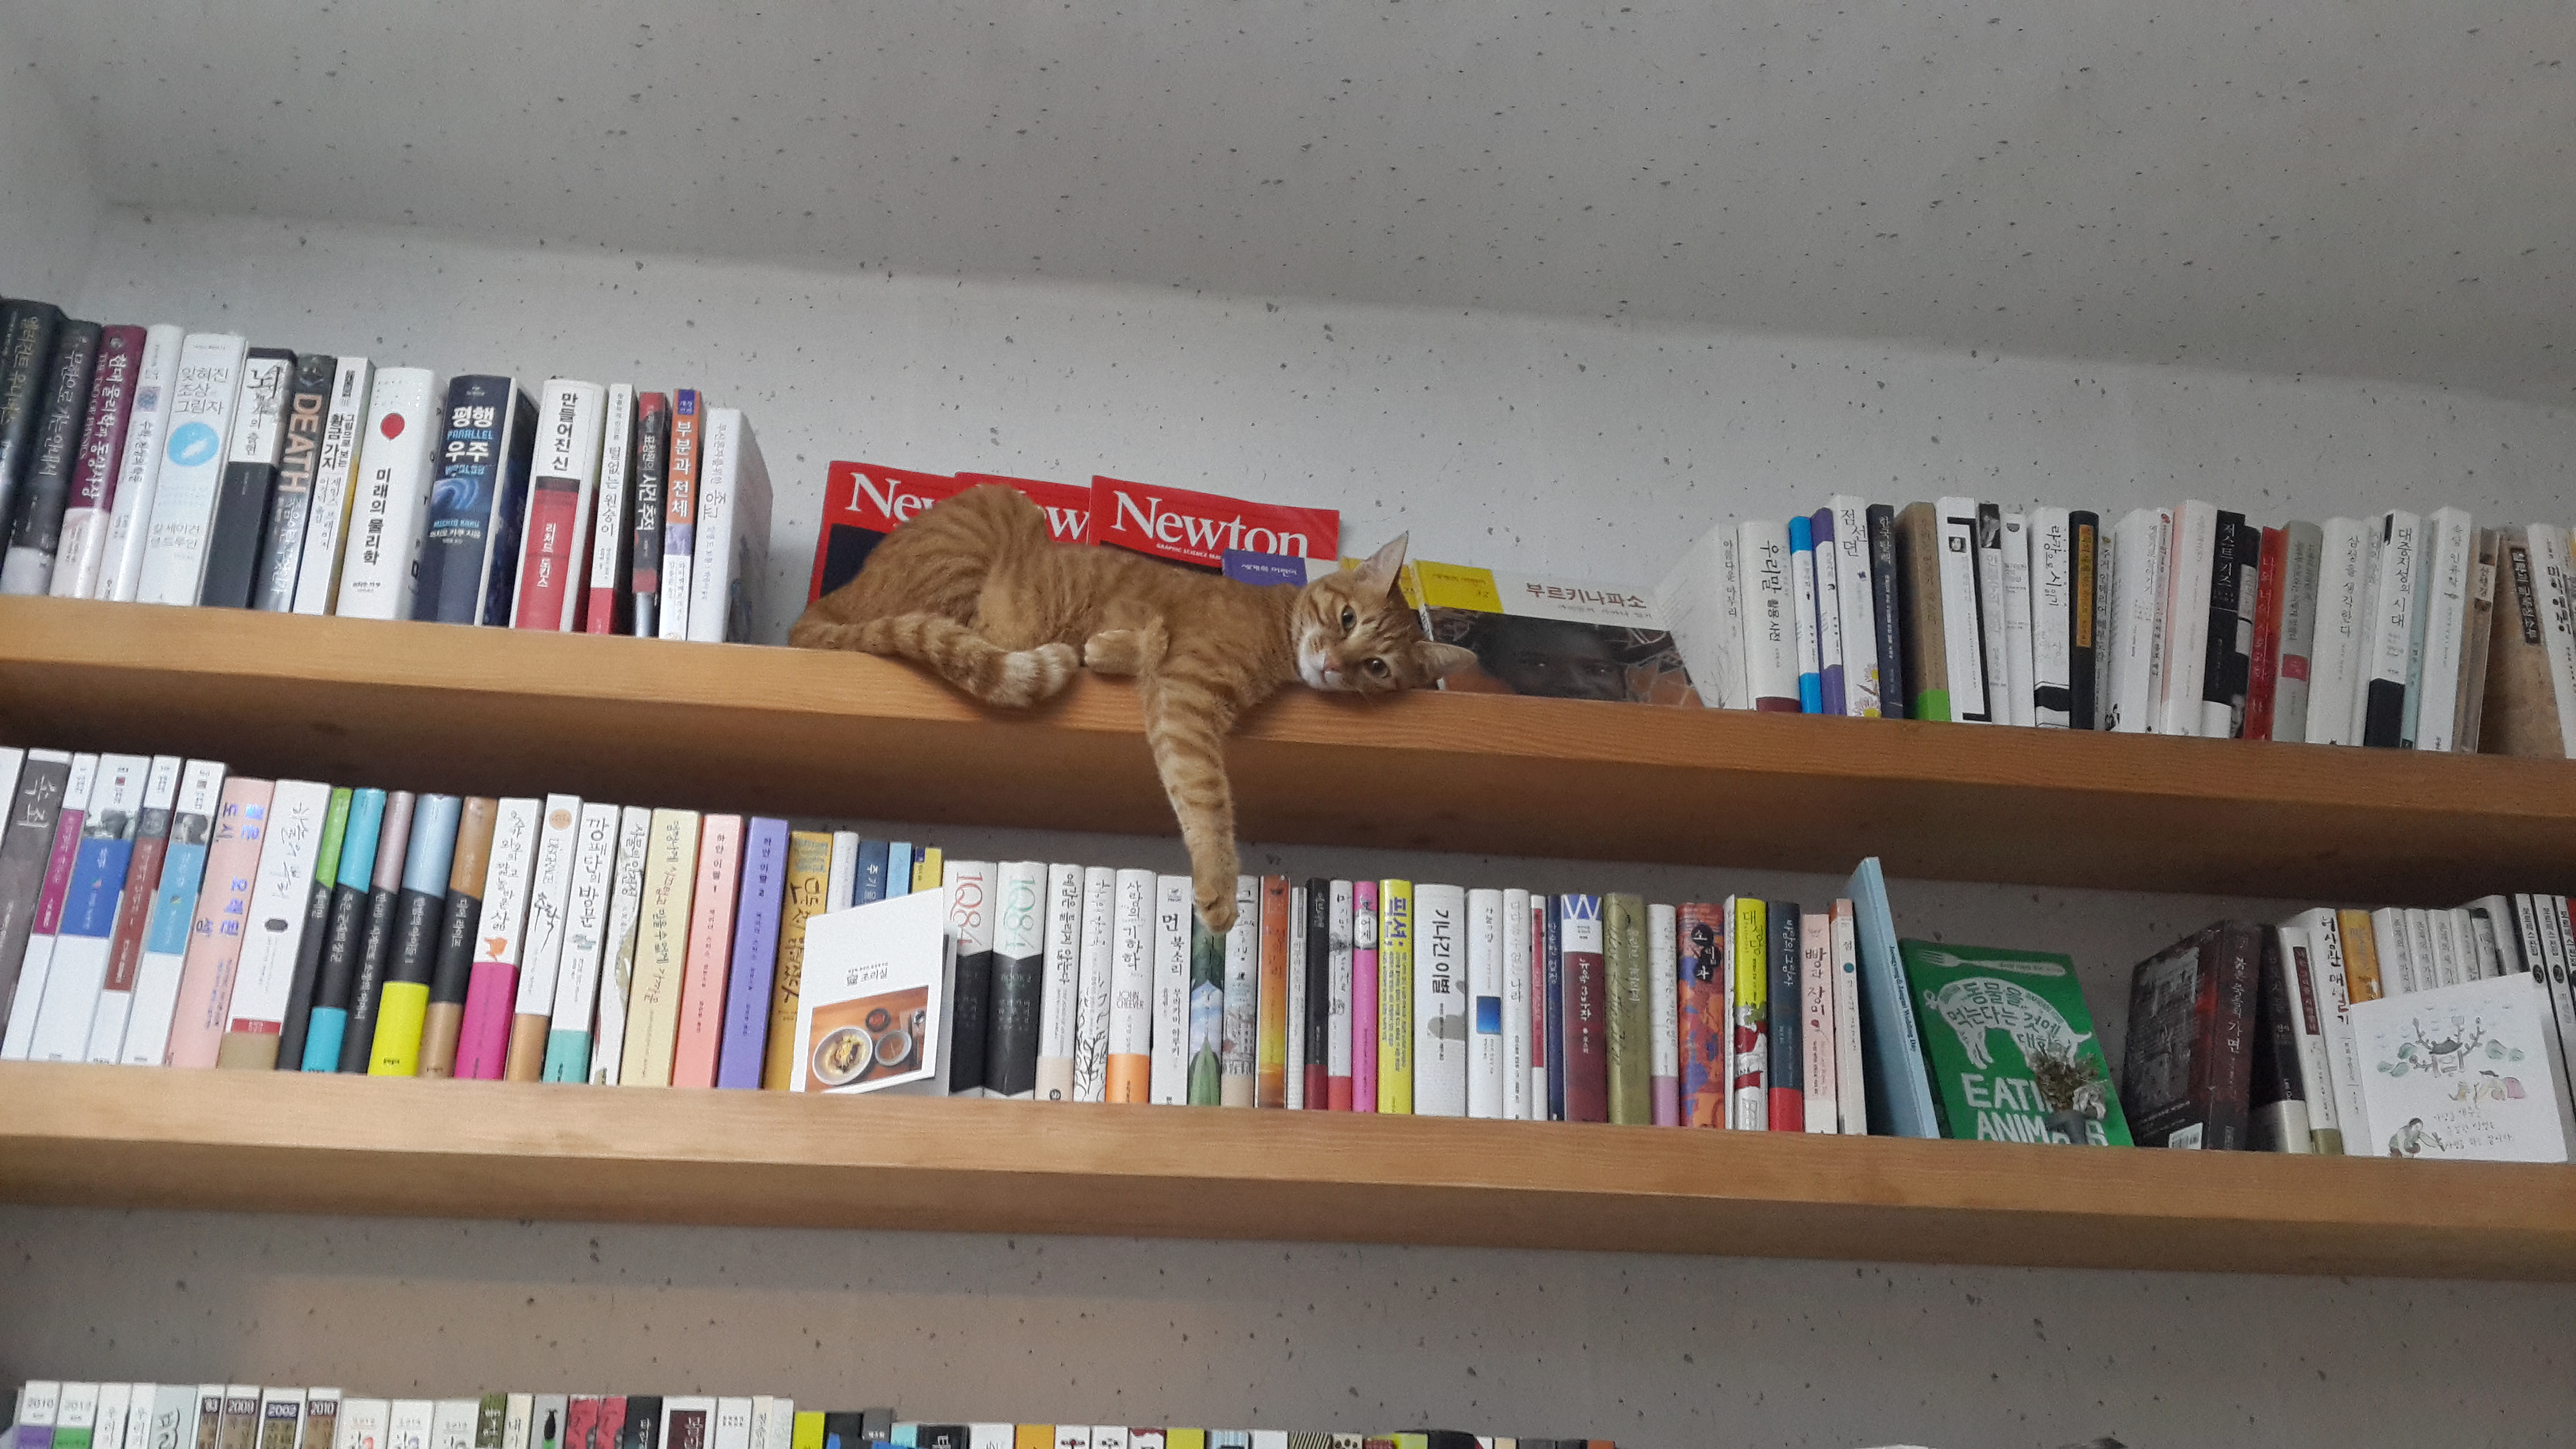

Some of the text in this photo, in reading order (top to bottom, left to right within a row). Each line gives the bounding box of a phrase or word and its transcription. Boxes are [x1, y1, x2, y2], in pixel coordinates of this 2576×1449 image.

[451, 406, 495, 429] 평행
[552, 391, 579, 473] 만들어진 신
[279, 393, 324, 494] DEATH
[321, 442, 340, 471] 가지
[444, 441, 490, 463] 우주
[369, 467, 393, 515] 미래의
[671, 421, 693, 519] 부분과 전체
[703, 489, 727, 520] 종교
[1109, 489, 1309, 559] Newton
[363, 518, 384, 565] 물리학
[1842, 509, 1868, 557] 점선면
[2218, 522, 2236, 588] 저스트 키즈
[1759, 539, 1782, 593] 우리말
[2391, 527, 2413, 629] 대중지성의 시대
[1526, 582, 1647, 609] 부르키나파소
[16, 774, 57, 829] 속죄
[578, 816, 610, 929] 깡패단의 방문
[864, 862, 879, 901] 주기율
[1061, 873, 1079, 908] 예감은
[220, 874, 248, 937] 오래된
[490, 909, 509, 932] 삶
[950, 871, 984, 947] 1Q84
[1003, 875, 1036, 950] 1Q84
[1162, 912, 1185, 977] 먼 북소리
[1432, 909, 1451, 995] 기나긴 이별
[1742, 910, 1765, 955] 대성당
[1781, 919, 1797, 987] 바람의 그림자
[643, 967, 665, 1005] 가까운
[1056, 949, 1074, 985] 않는다
[1805, 947, 1828, 1017] 빵과 장미
[1118, 990, 1139, 1002] JOHN
[1963, 982, 2024, 1009] 동물을
[1901, 1003, 1914, 1038] Wedding
